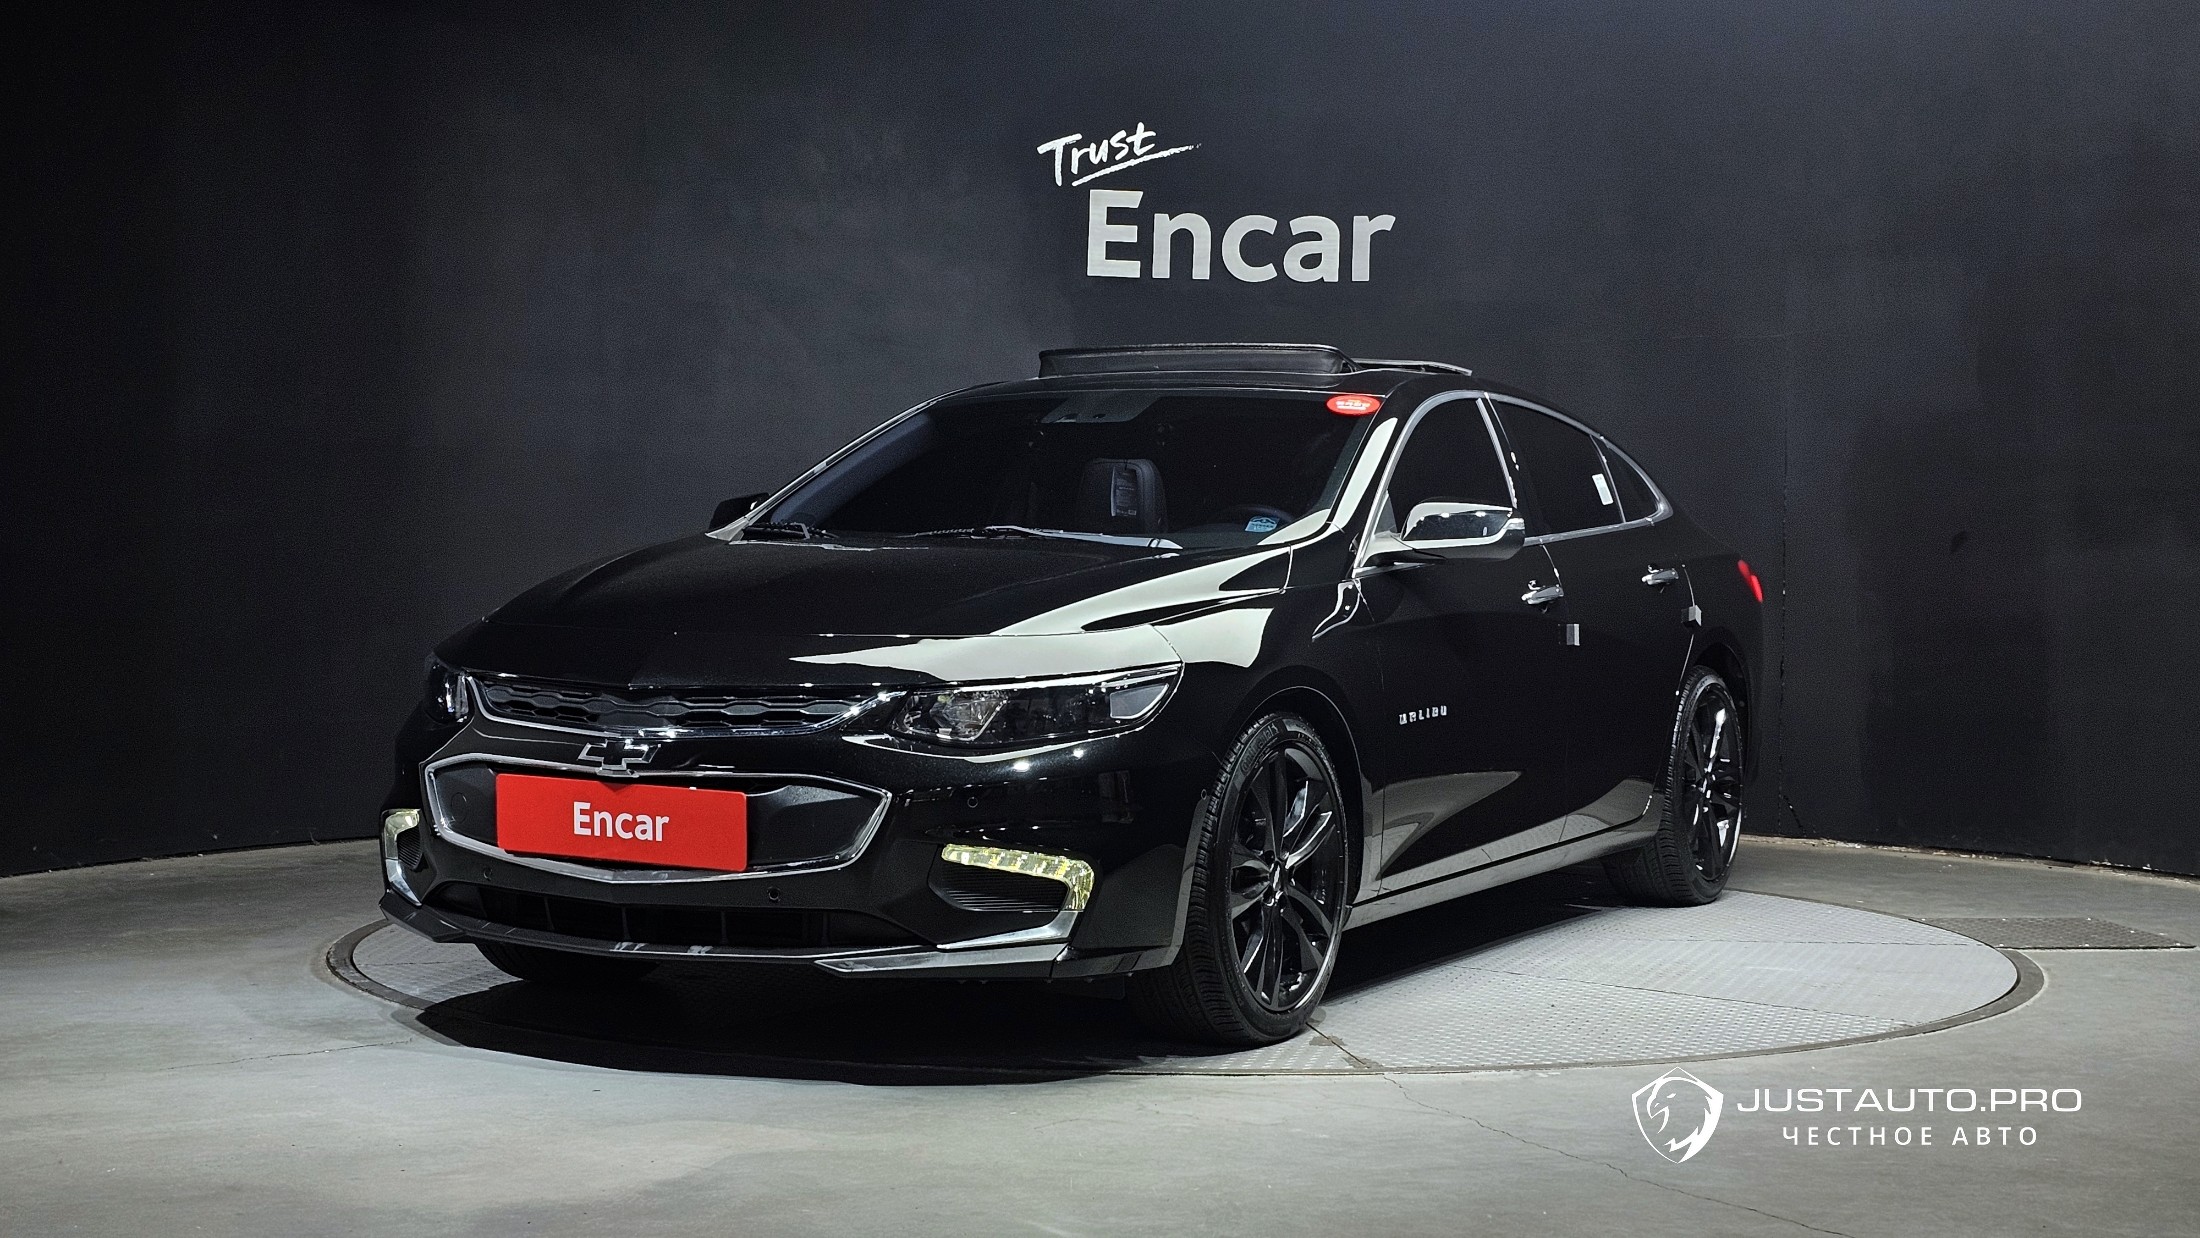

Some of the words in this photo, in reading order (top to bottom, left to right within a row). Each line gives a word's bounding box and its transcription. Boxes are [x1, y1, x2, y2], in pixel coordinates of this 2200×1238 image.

[1037, 122, 1157, 186] Trust
[1087, 189, 1396, 283] Encar
[1399, 705, 1447, 725] MALIBU
[573, 801, 669, 842] Encar
